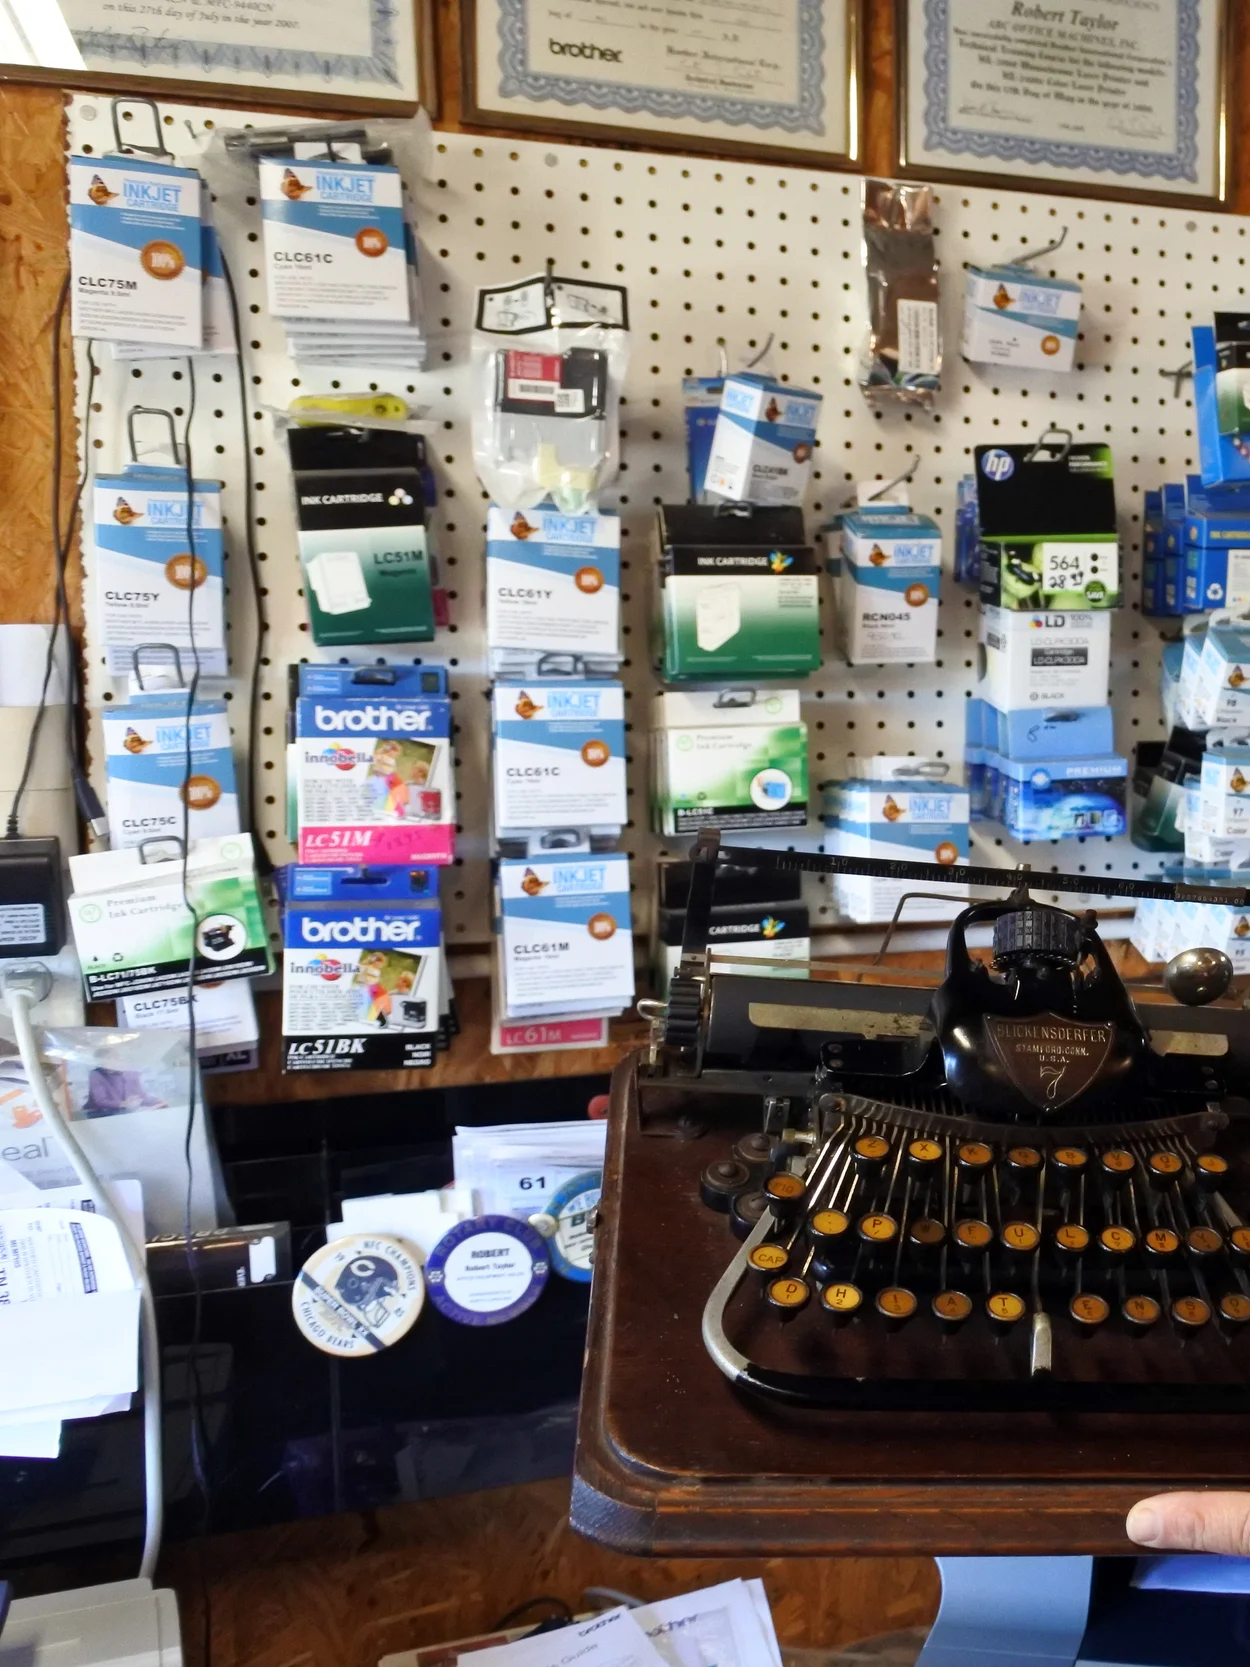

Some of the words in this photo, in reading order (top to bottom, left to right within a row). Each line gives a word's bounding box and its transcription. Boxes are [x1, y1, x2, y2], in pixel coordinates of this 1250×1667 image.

[1011, 1, 1064, 23] Robert
[1070, 9, 1119, 31] Taylor
[548, 38, 623, 63] brother
[316, 175, 375, 193] INKJET
[123, 182, 182, 203] INKJET
[274, 252, 333, 263] CLC61C
[78, 276, 138, 290] CLC75M
[986, 450, 1009, 481] hp
[302, 495, 321, 505] INK
[322, 493, 384, 504] CARTRIDGE
[147, 502, 205, 517] INKJT
[373, 550, 423, 564] LC51M
[715, 557, 768, 566] CARTRIDGE
[1049, 556, 1080, 570] 564
[105, 591, 160, 601] CLC75Y
[498, 588, 552, 599] CLC61Y
[1045, 616, 1065, 627] LD
[315, 705, 432, 731] brother
[305, 751, 374, 763] innobella
[507, 767, 560, 777] CLC61C
[122, 816, 177, 828] CLC75C
[306, 830, 373, 847] LC51M
[553, 868, 605, 884] INKJET
[107, 894, 156, 907] Premium
[130, 902, 183, 916] Cartridge
[302, 917, 421, 942] brother
[709, 924, 761, 935] CARTRIDGE
[514, 942, 569, 954] CLC61M
[290, 962, 360, 974] innobella
[997, 1025, 1107, 1043] BLICKENSDERFER
[289, 1038, 367, 1054] LC51BK
[1040, 1065, 1066, 1099] 7
[520, 1176, 546, 1190] 61
[471, 1248, 510, 1258] ROBERT
[758, 1253, 783, 1264] CAP
[300, 1301, 326, 1337] CHICAGO
[326, 1336, 354, 1349] BEARS
[561, 1643, 598, 1664] Guide
